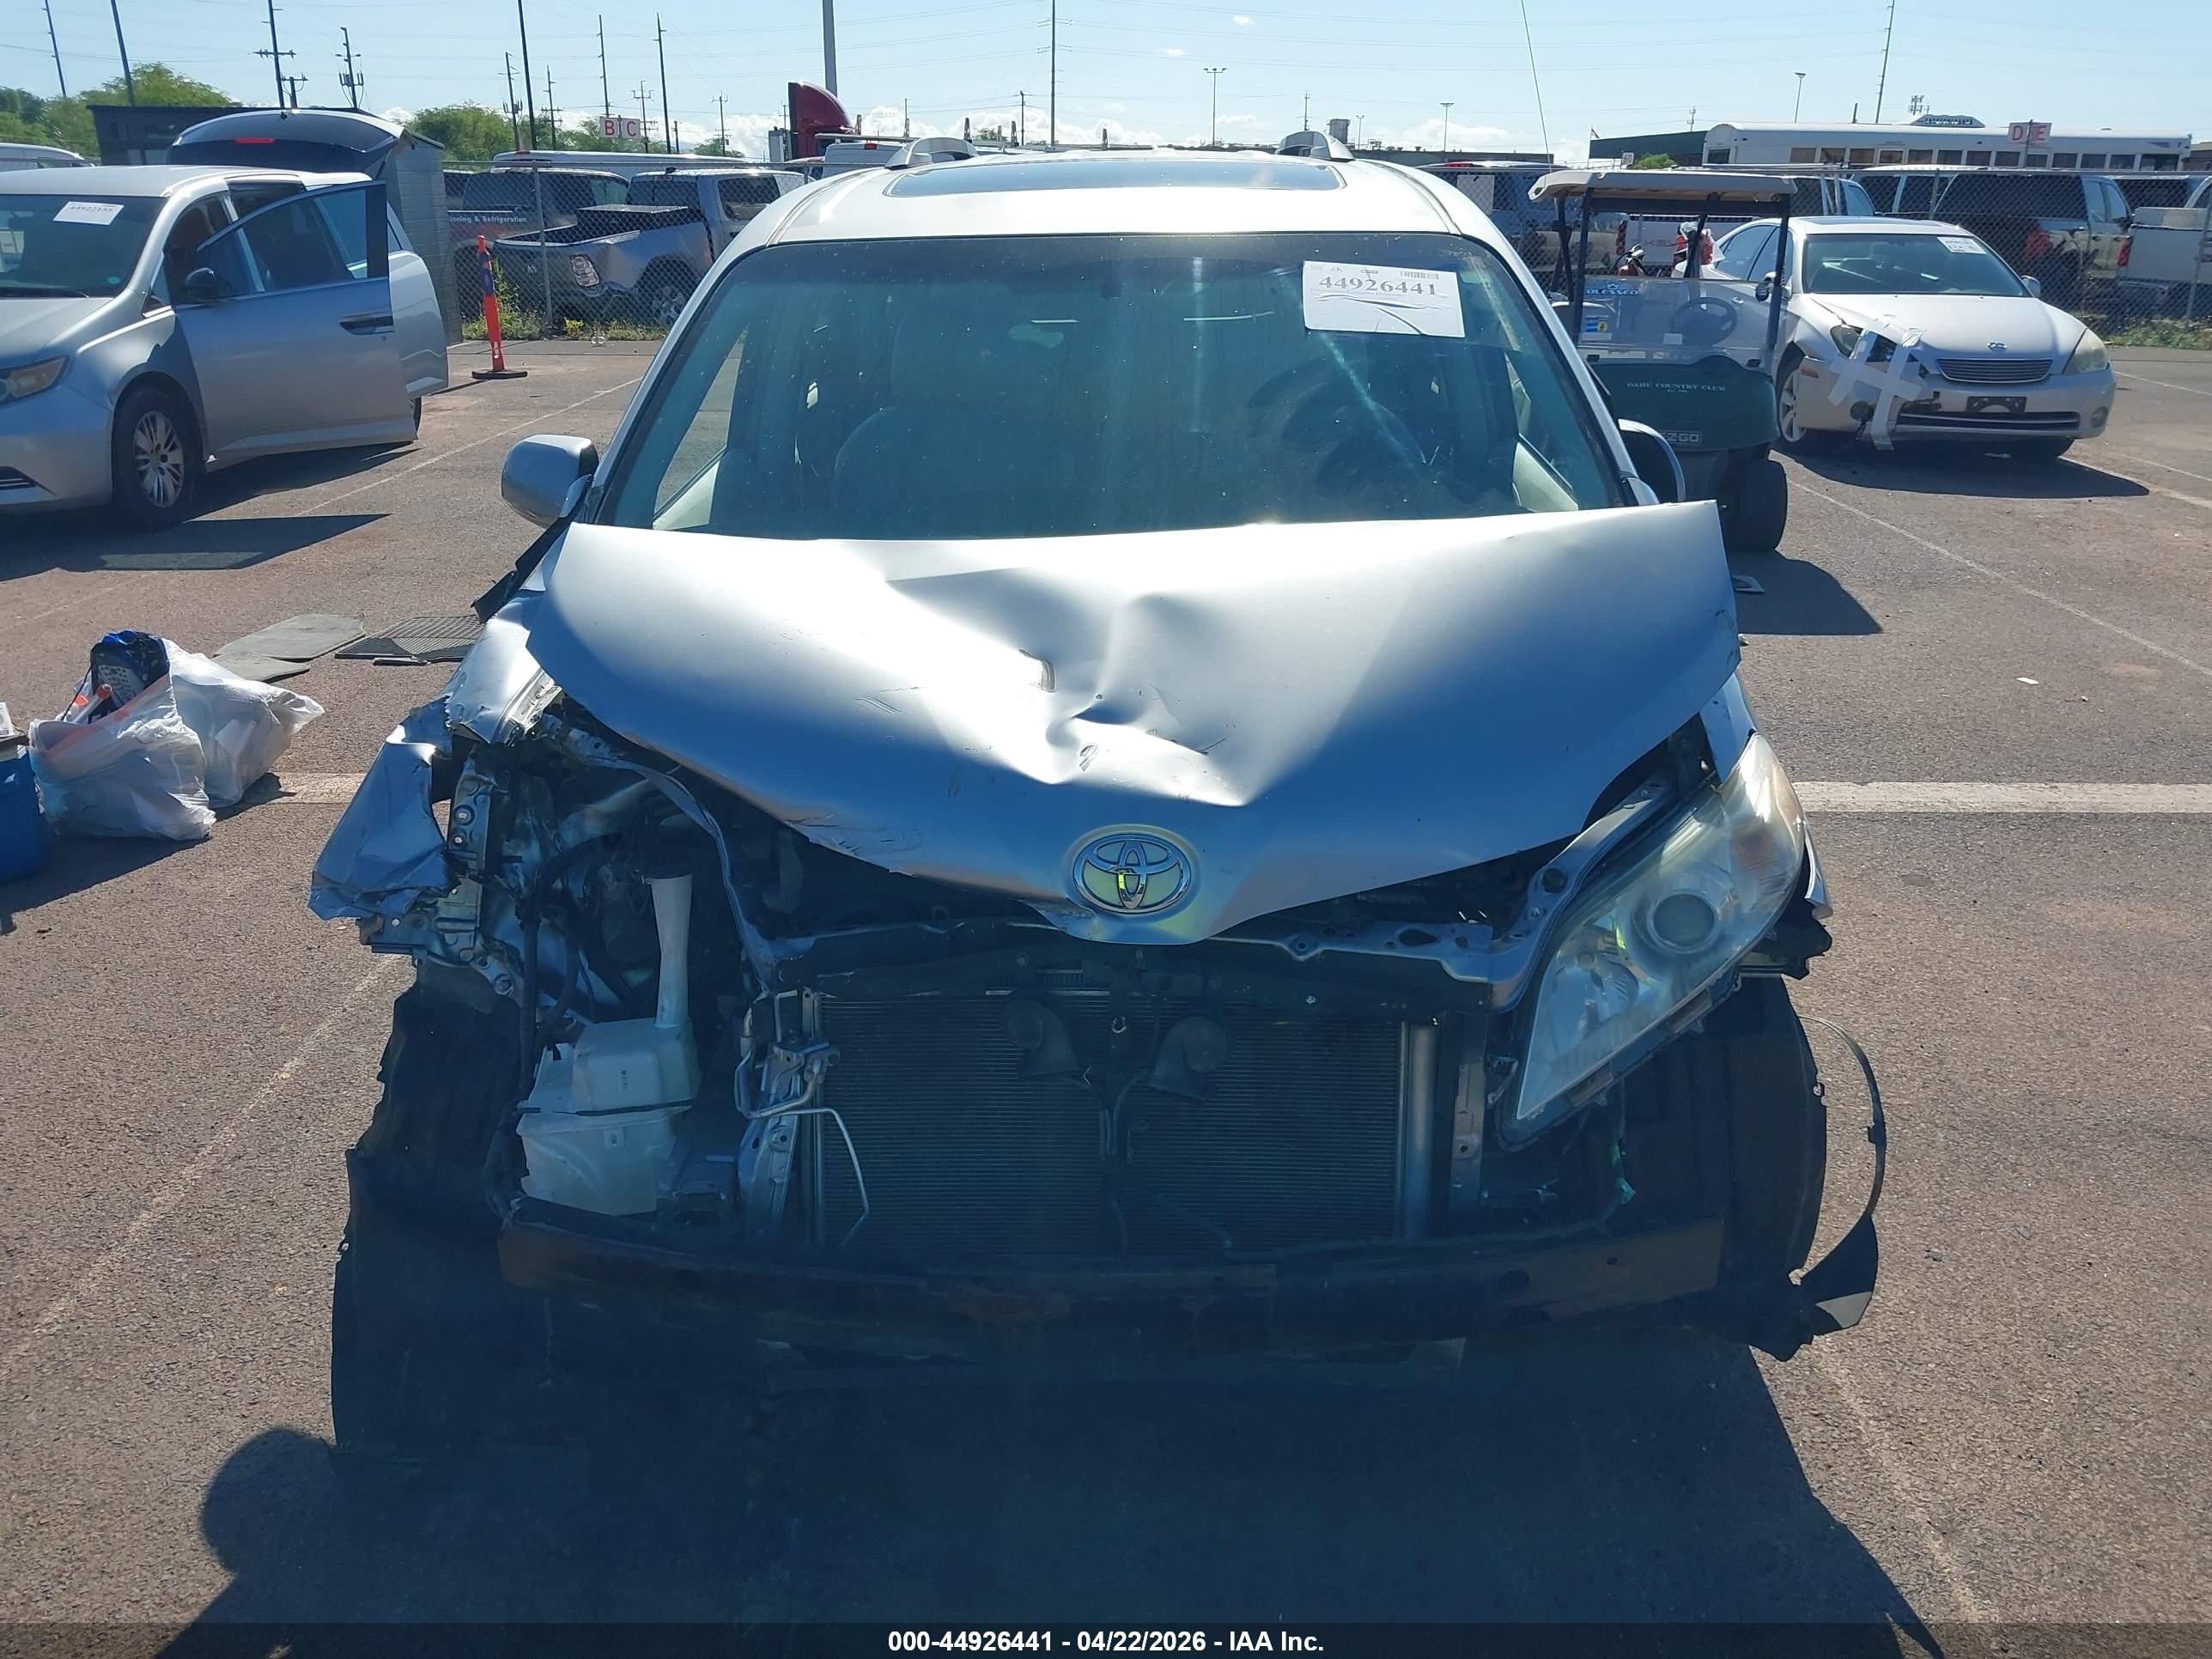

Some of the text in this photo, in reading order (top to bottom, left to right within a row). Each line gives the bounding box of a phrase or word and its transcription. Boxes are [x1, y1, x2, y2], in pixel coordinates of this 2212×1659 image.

[605, 120, 636, 137] B C
[2012, 125, 2047, 141] D E
[1318, 276, 1437, 295] 44926441
